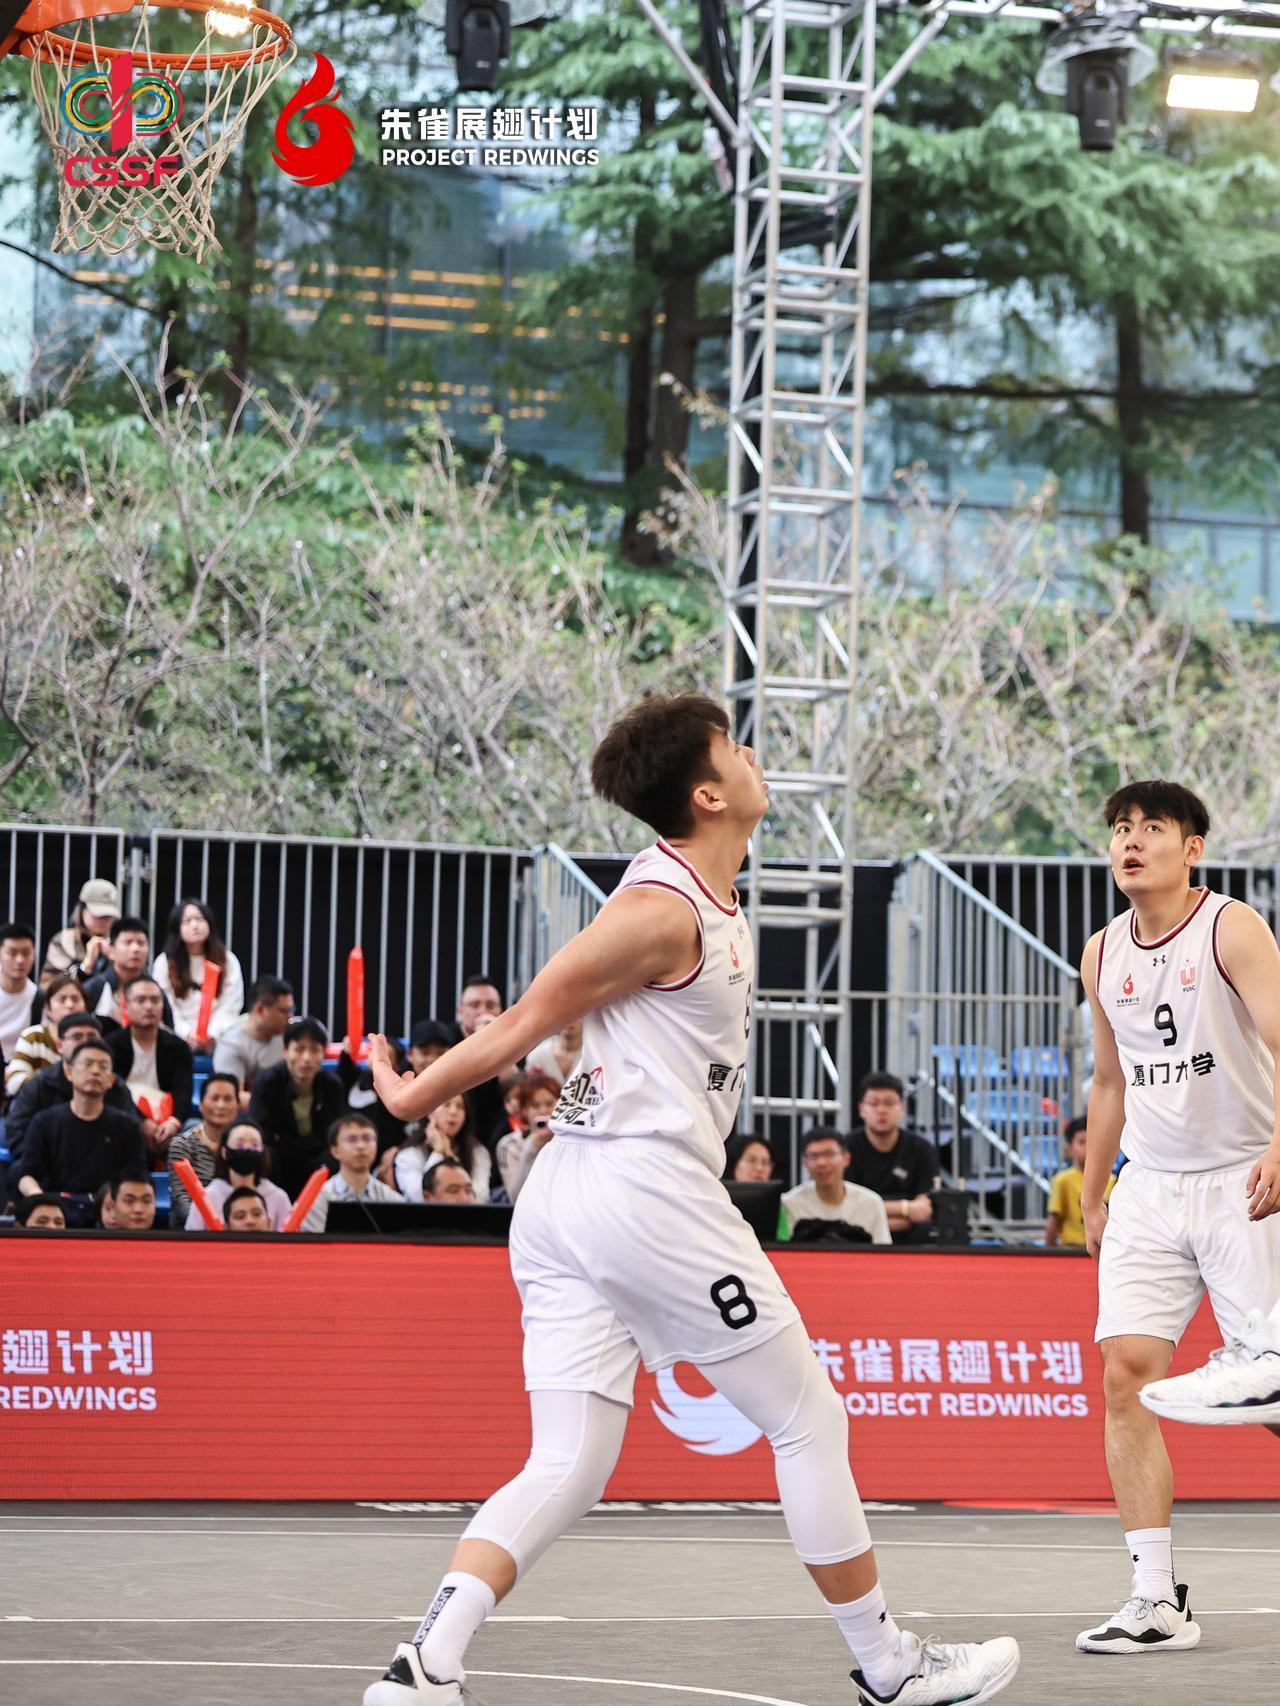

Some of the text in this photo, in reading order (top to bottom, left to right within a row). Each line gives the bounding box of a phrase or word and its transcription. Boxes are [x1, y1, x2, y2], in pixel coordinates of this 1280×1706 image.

[1154, 1003, 1178, 1047] 9
[1131, 1051, 1216, 1087] 厦门大学
[710, 1274, 758, 1330] 8
[845, 1391, 1089, 1417] OJECT REDWINGS
